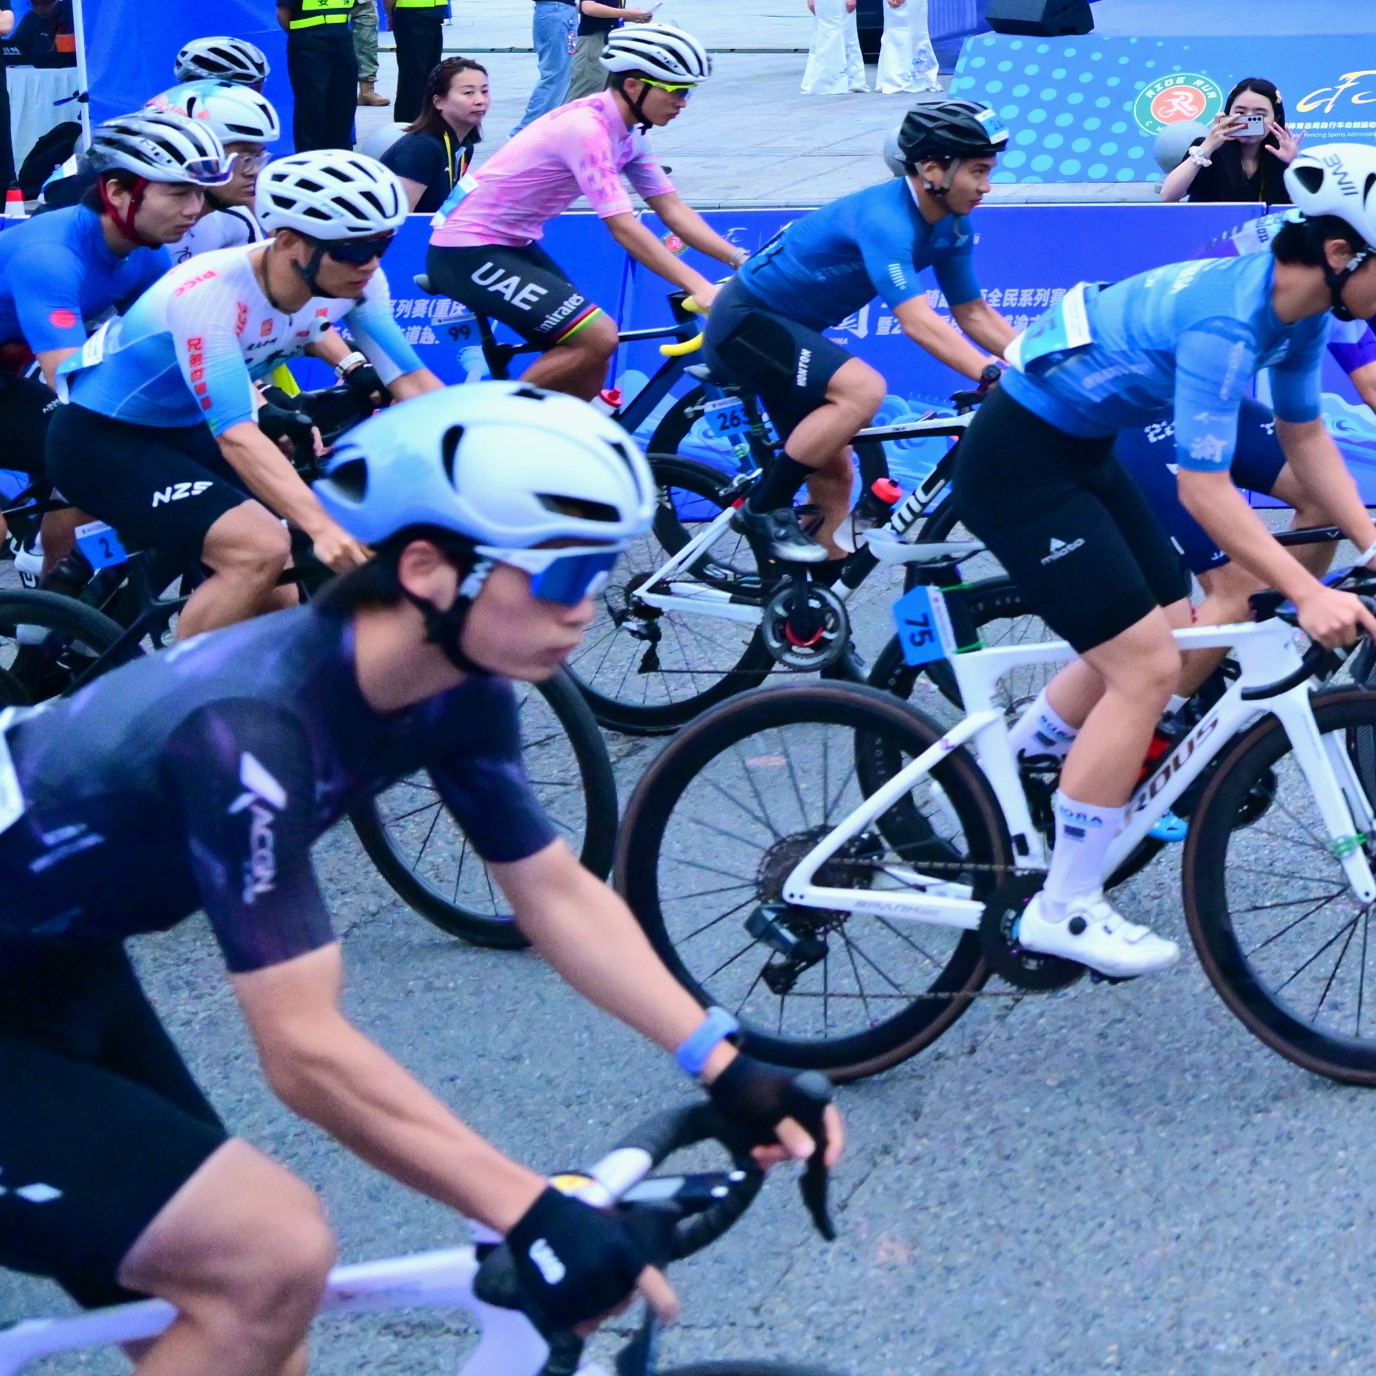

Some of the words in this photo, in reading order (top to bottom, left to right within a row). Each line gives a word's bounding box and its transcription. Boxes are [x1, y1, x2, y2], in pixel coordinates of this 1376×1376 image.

[1144, 75, 1187, 100] RIDE
[1192, 77, 1218, 101] RUN
[471, 261, 548, 311] UAE
[903, 611, 935, 649] 75
